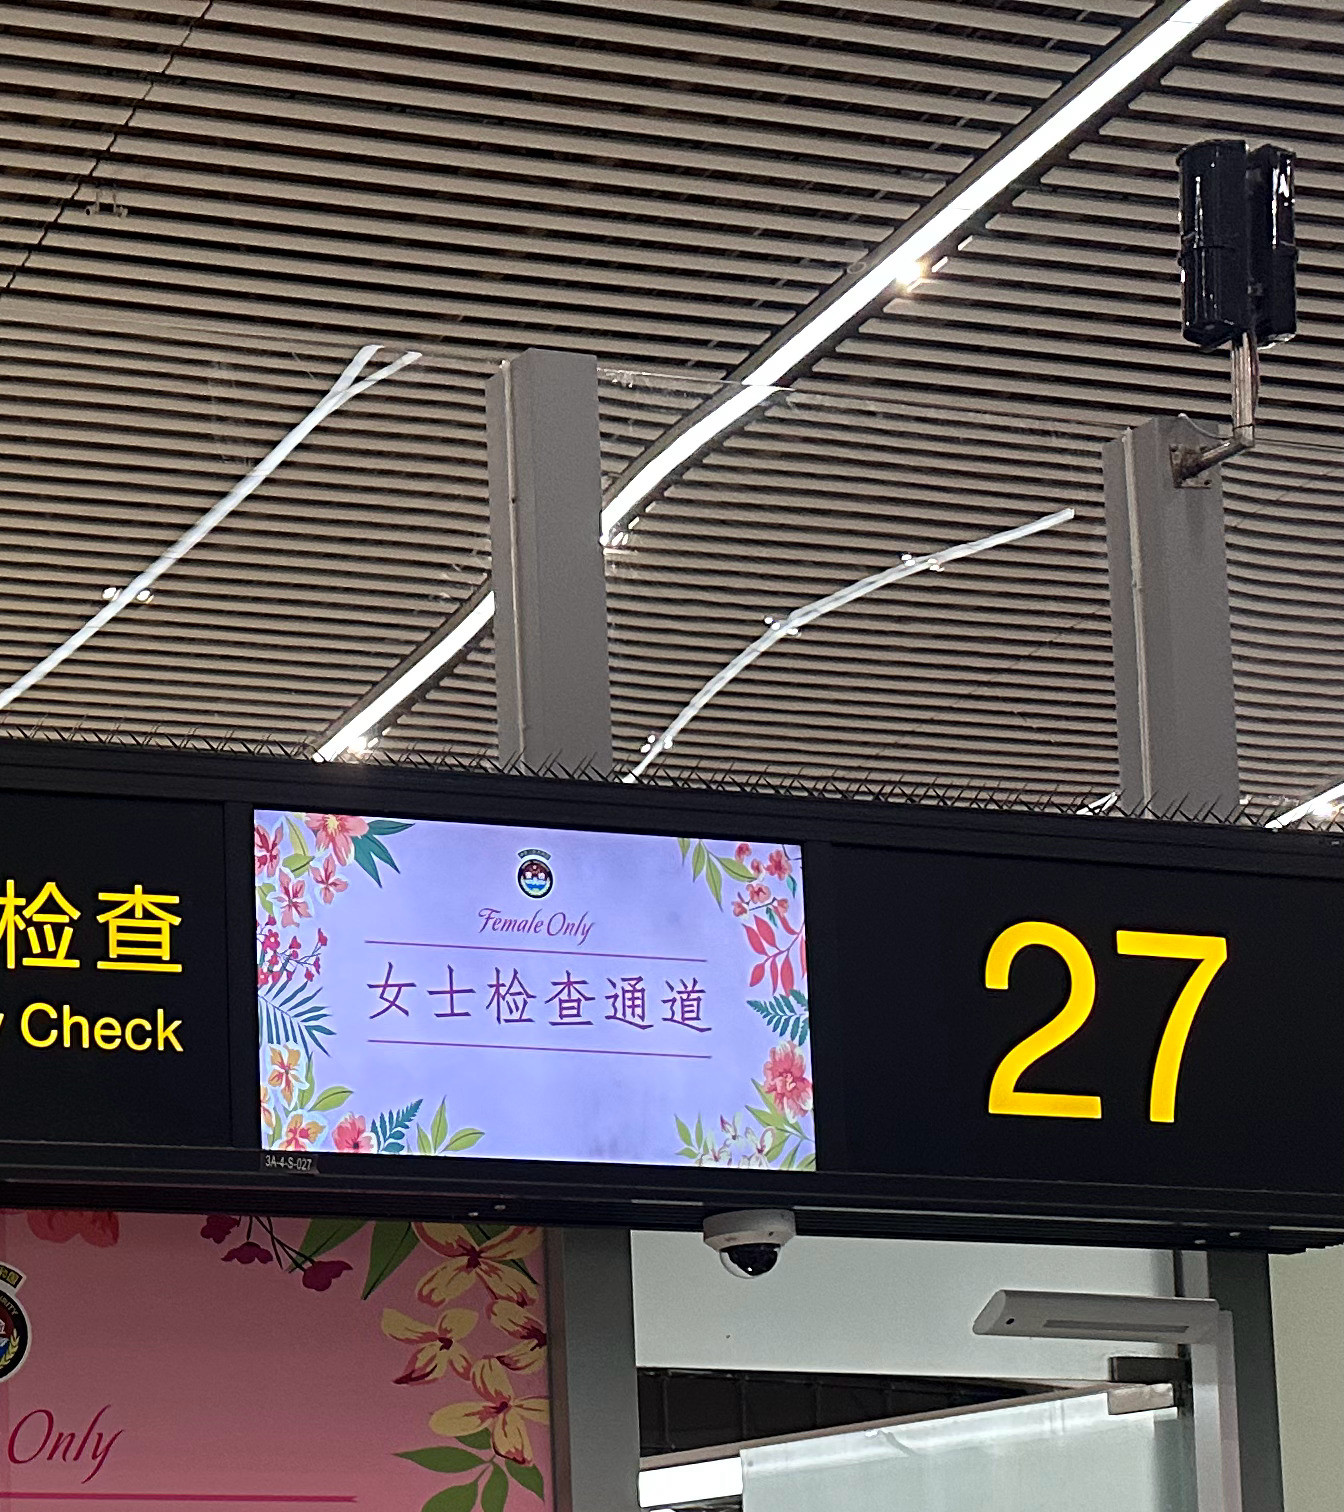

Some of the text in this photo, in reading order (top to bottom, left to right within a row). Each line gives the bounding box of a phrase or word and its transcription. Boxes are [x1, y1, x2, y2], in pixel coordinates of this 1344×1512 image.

[478, 908, 595, 946] Female Only
[21, 1002, 184, 1053] Check
[367, 962, 713, 1033] 女士检查通道
[985, 921, 1227, 1123] 27
[6, 1405, 126, 1484] Only
